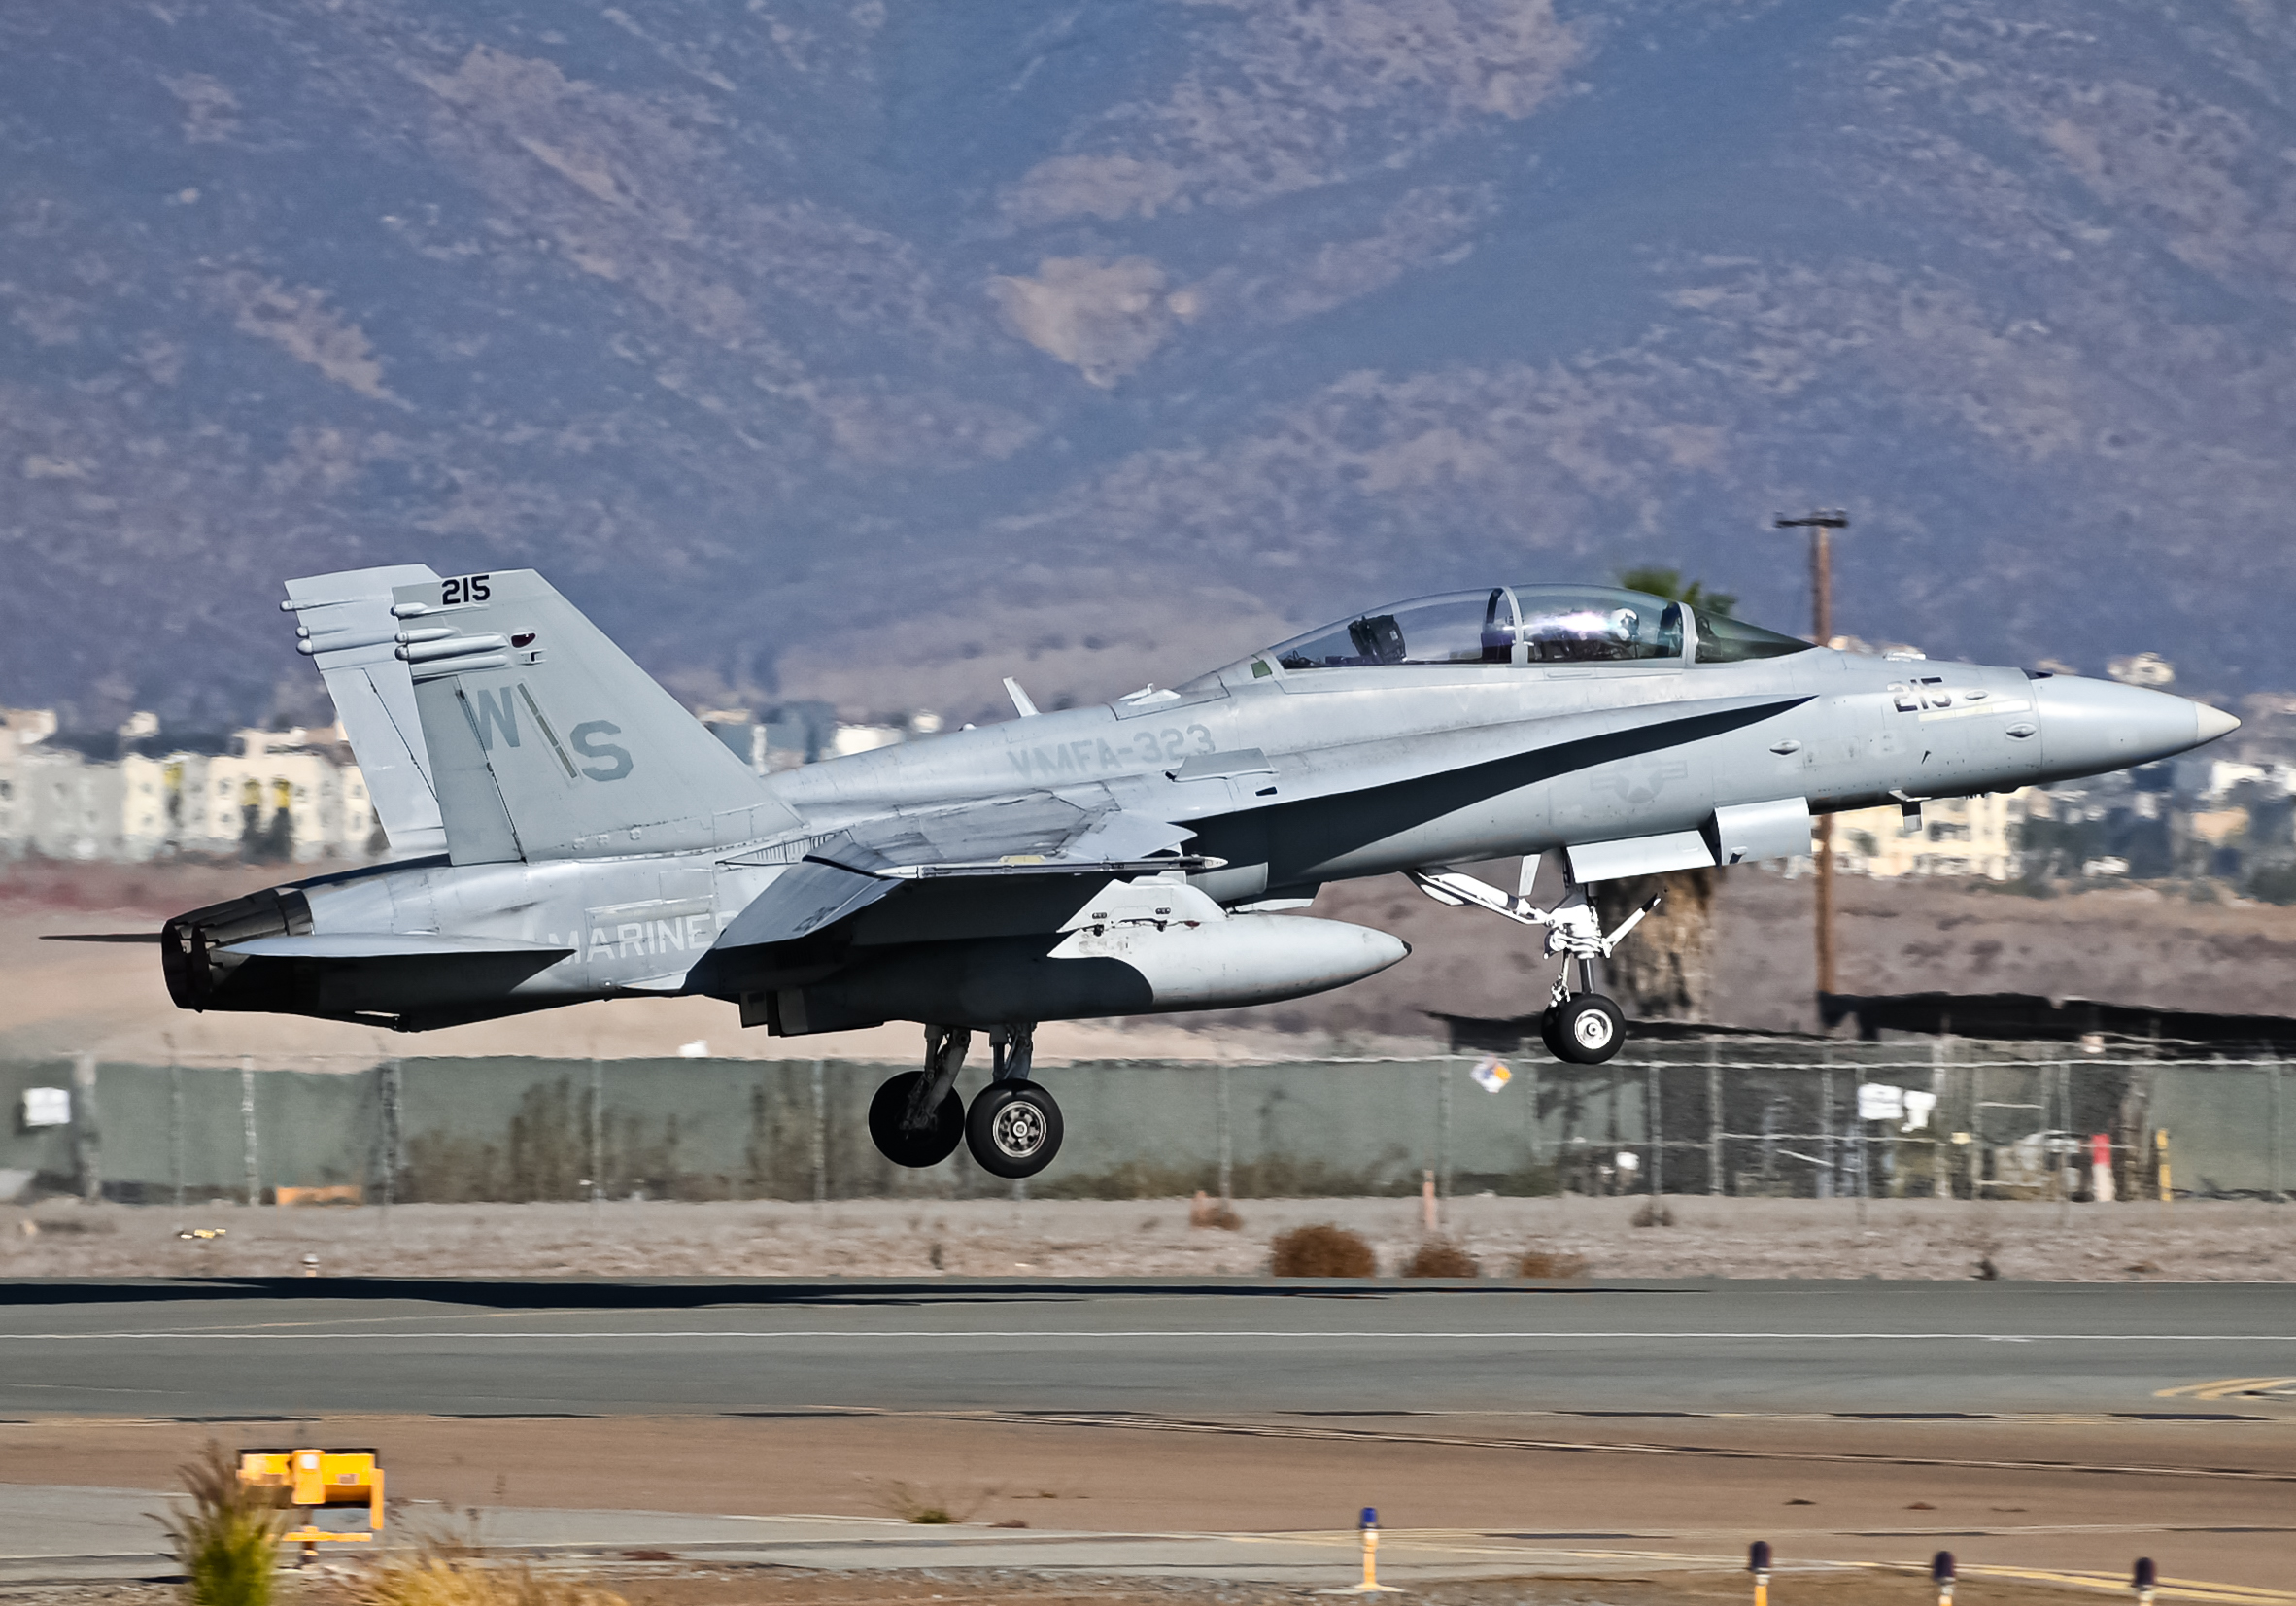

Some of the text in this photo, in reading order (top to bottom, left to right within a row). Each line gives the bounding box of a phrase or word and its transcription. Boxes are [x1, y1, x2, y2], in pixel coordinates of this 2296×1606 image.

[441, 574, 491, 606] 215
[1886, 676, 1952, 713] 215
[1006, 724, 1216, 778] VMFA-323
